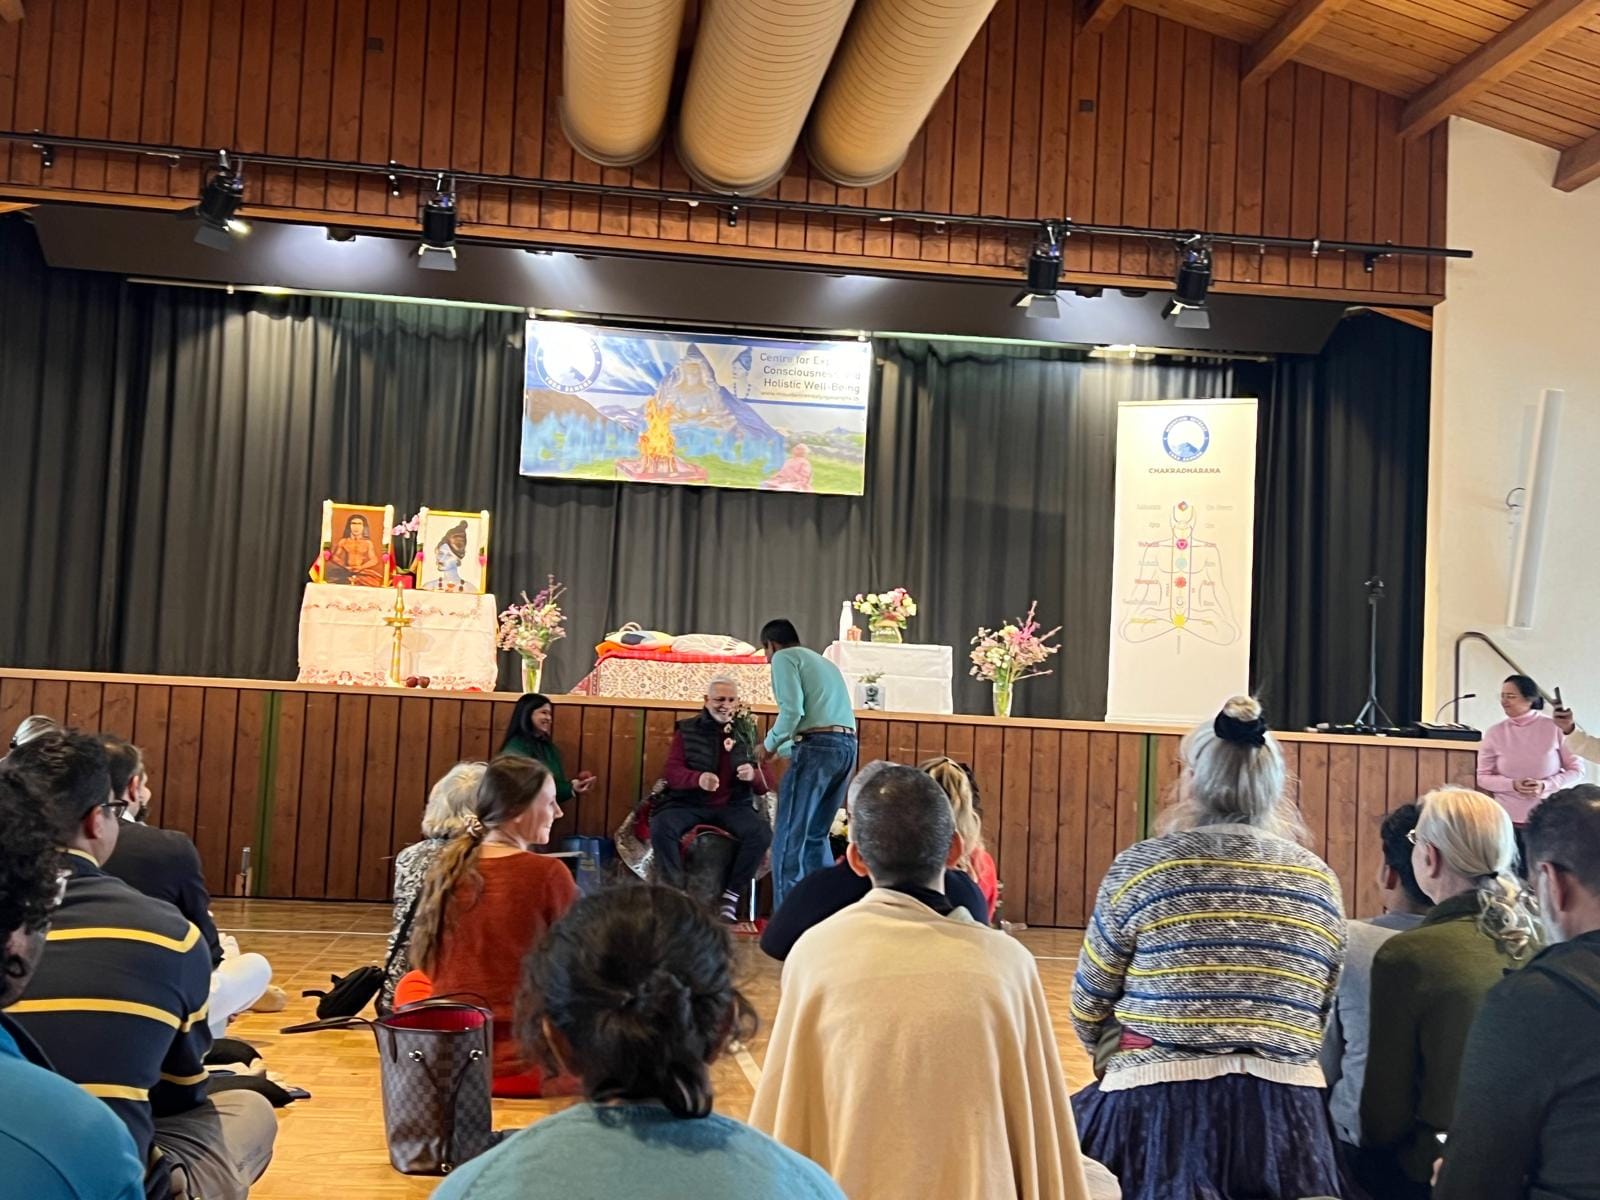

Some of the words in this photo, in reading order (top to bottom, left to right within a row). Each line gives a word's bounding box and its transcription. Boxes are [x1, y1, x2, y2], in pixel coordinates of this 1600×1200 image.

[760, 352, 794, 363] Centre
[796, 355, 810, 365] for
[763, 365, 840, 378] Consciousne
[763, 378, 801, 389] Holistic
